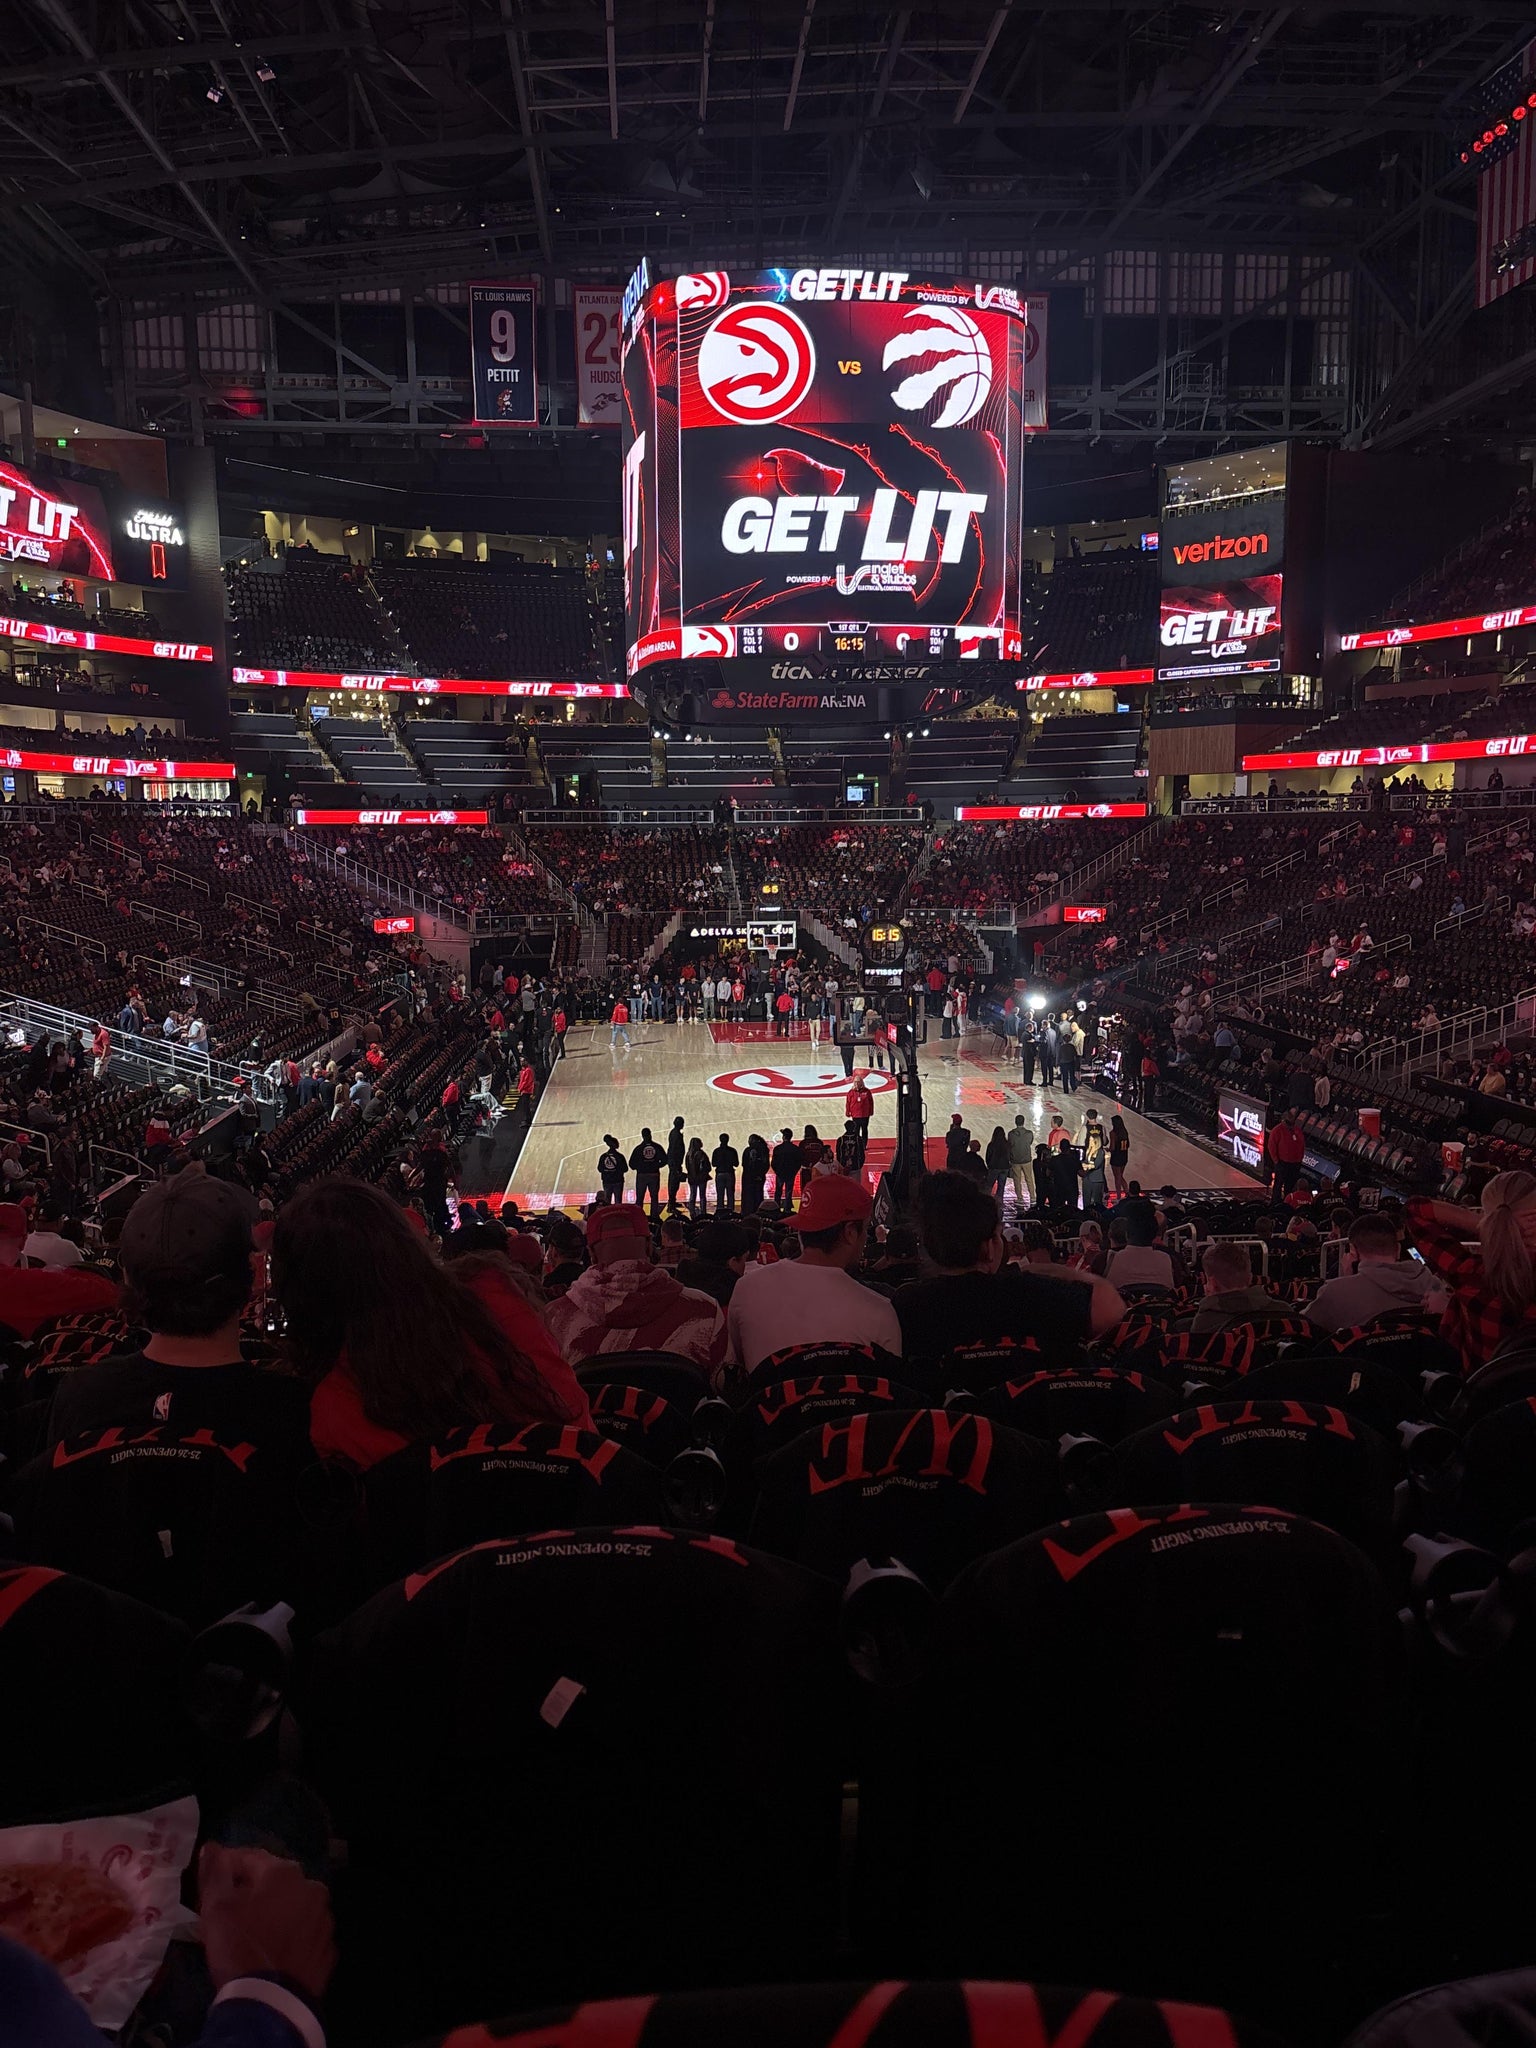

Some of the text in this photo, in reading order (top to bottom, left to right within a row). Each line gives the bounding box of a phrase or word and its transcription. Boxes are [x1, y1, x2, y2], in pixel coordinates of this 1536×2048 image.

[789, 268, 909, 302] GET LIT
[485, 292, 504, 301] LOUIS
[506, 292, 531, 302] HAWKS
[579, 295, 609, 304] ATLANTA
[916, 291, 969, 305] POWERED BY
[490, 309, 516, 363] 9
[487, 368, 520, 383] PETTIT
[838, 360, 862, 376] VS
[590, 370, 622, 384] HUDSO
[27, 496, 79, 541] LIT
[721, 488, 988, 564] GET LIT
[126, 520, 184, 547] ULTRA
[1173, 533, 1269, 565] verizon
[786, 575, 832, 584] POWERED BY
[1160, 606, 1277, 646] GET LIT
[1482, 609, 1523, 630] GET LIT
[9, 619, 29, 638] LIT
[743, 627, 755, 637] FLS
[757, 636, 763, 645] 7
[783, 632, 799, 651] 0
[834, 637, 864, 651] 16:15
[1340, 634, 1361, 651] LIT
[153, 643, 177, 657] GET
[178, 644, 199, 660] LIT
[340, 675, 386, 690] GET LIT
[508, 683, 533, 695] GET
[532, 682, 552, 696] LIT
[1026, 675, 1047, 690] LIT
[820, 694, 867, 708] ARENA
[1485, 737, 1528, 755] GET LIT
[73, 757, 94, 772] GET
[93, 757, 111, 774] LIT
[1316, 751, 1342, 765] GET
[1341, 750, 1362, 766] LIT
[358, 811, 383, 824] GET
[382, 811, 402, 825] LIT
[1018, 806, 1041, 818] GET
[1042, 805, 1063, 819] LIT
[701, 928, 734, 936] DELTA
[871, 928, 900, 942] 16:15
[875, 968, 903, 976] TISSOT
[1220, 1431, 1248, 1446] NIGHT
[1247, 1429, 1286, 1440] OPENING
[109, 1447, 202, 1465] 25-26 OPENING NIGHT
[481, 1459, 570, 1475] 25-26 OPENING NIGHT
[1150, 1519, 1291, 1553] 25-26 OPENING NIGHT
[495, 1542, 653, 1567] 25-26 OPENING NIGHT
